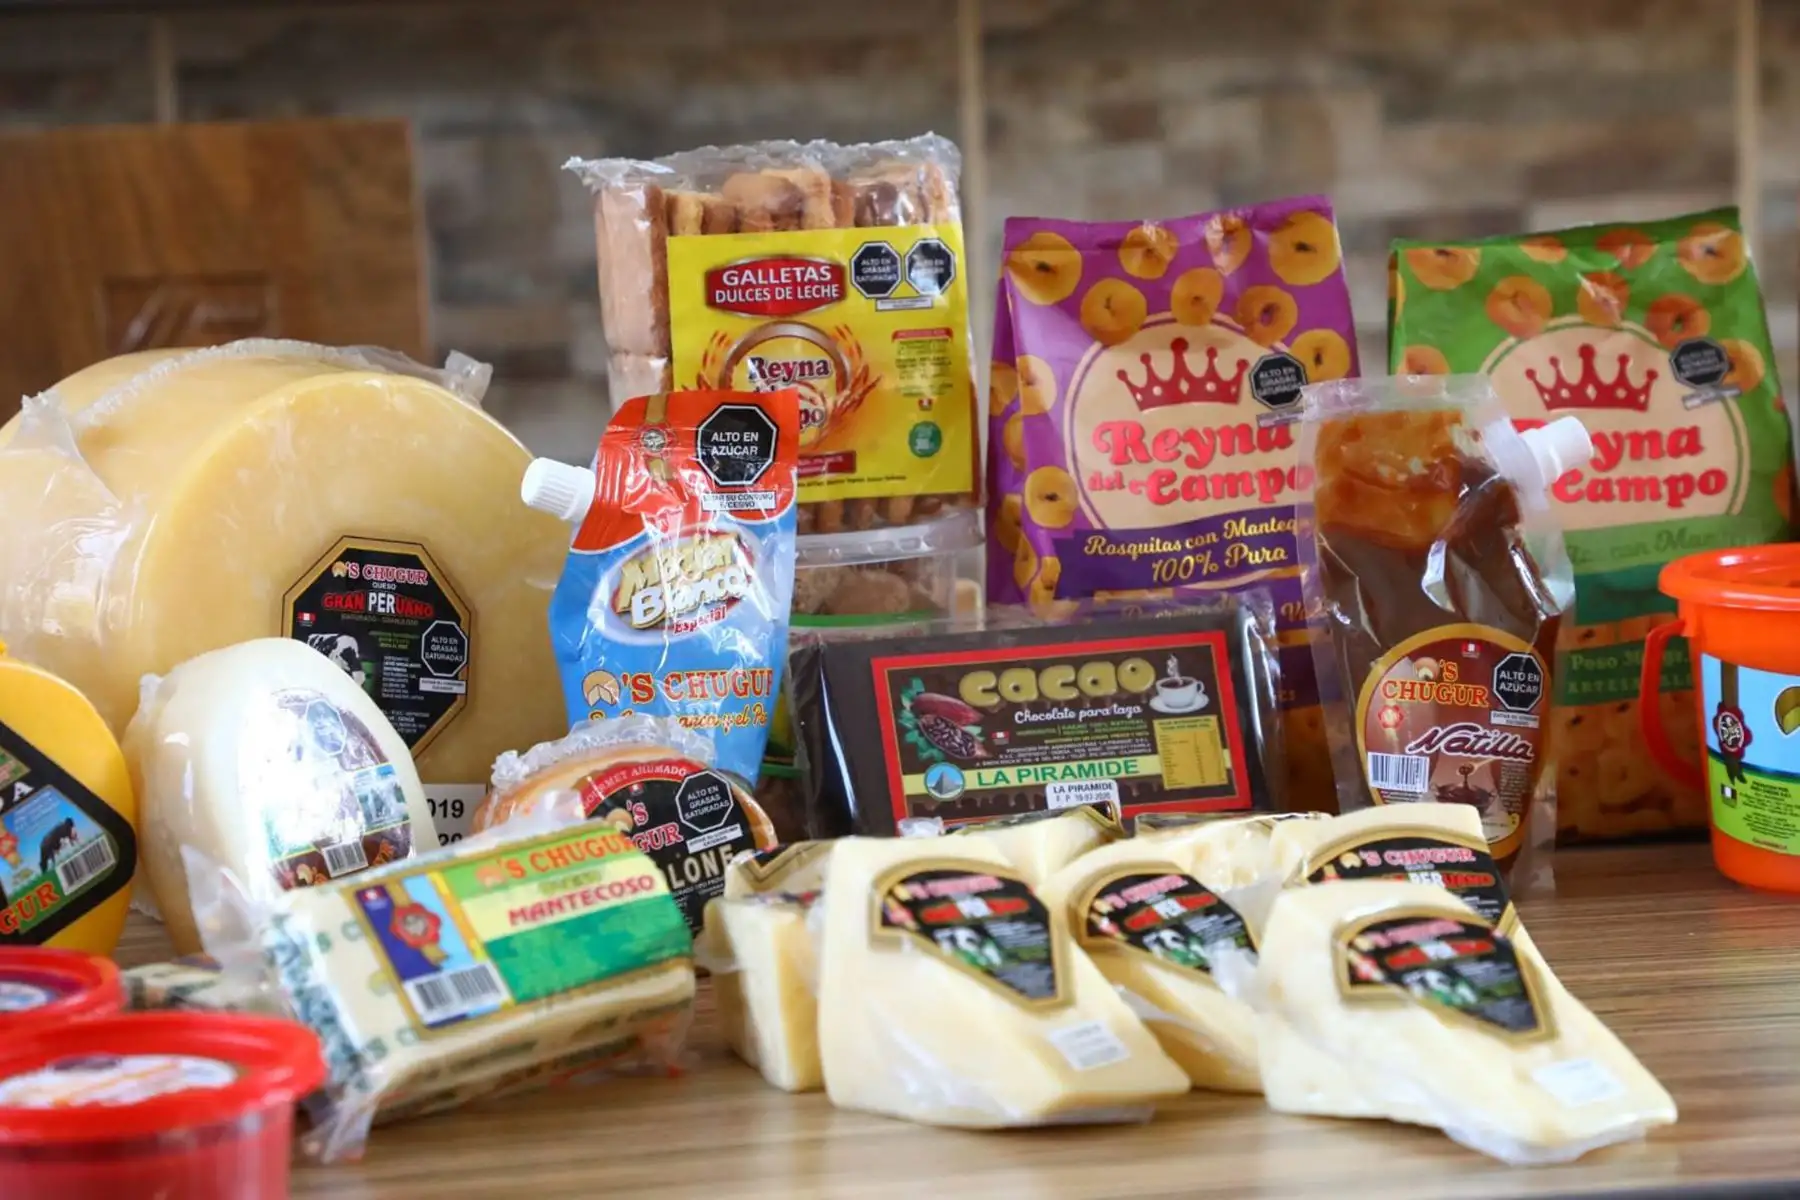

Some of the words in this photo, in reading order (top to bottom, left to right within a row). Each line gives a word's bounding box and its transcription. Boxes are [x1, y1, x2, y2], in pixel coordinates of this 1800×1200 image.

[722, 265, 832, 286] GALLETAS
[715, 286, 771, 304] DULCES
[773, 285, 794, 301] DE
[796, 283, 840, 300] LECHE
[749, 357, 831, 384] Reyna
[711, 432, 740, 442] ALTO
[743, 432, 759, 442] EN
[711, 443, 759, 456] AZÚCAR
[1092, 420, 1294, 469] Reyna
[1087, 468, 1125, 492] del
[1128, 464, 1315, 506] Campo
[1552, 467, 1729, 508] Campo
[1084, 534, 1182, 561] Rosquitas
[1185, 531, 1220, 548] con
[346, 561, 360, 579] 'S
[362, 564, 429, 586] CHUGUR
[1153, 552, 1219, 583] 100%
[1225, 544, 1288, 569] Pura
[323, 591, 365, 611] GRAN
[368, 592, 435, 617] PERUANO
[1440, 659, 1458, 682] 'S
[1499, 670, 1526, 682] ALTO
[1527, 672, 1540, 683] EN
[622, 673, 655, 703] 'S
[1382, 680, 1490, 707] CHUGUR
[1015, 707, 1076, 724] Chocolate
[1079, 708, 1111, 722] para
[1405, 722, 1535, 763] Natilla
[976, 769, 1002, 787] LA
[1018, 758, 1141, 784] PIRAMIDE
[687, 789, 708, 801] ALTO
[707, 785, 719, 795] EN
[1053, 785, 1066, 794] LA
[1067, 782, 1113, 793] PIRAMIDE
[684, 800, 730, 820] SATURADAS
[689, 794, 722, 809] GRASAS
[508, 874, 656, 927] MANTECOSO
